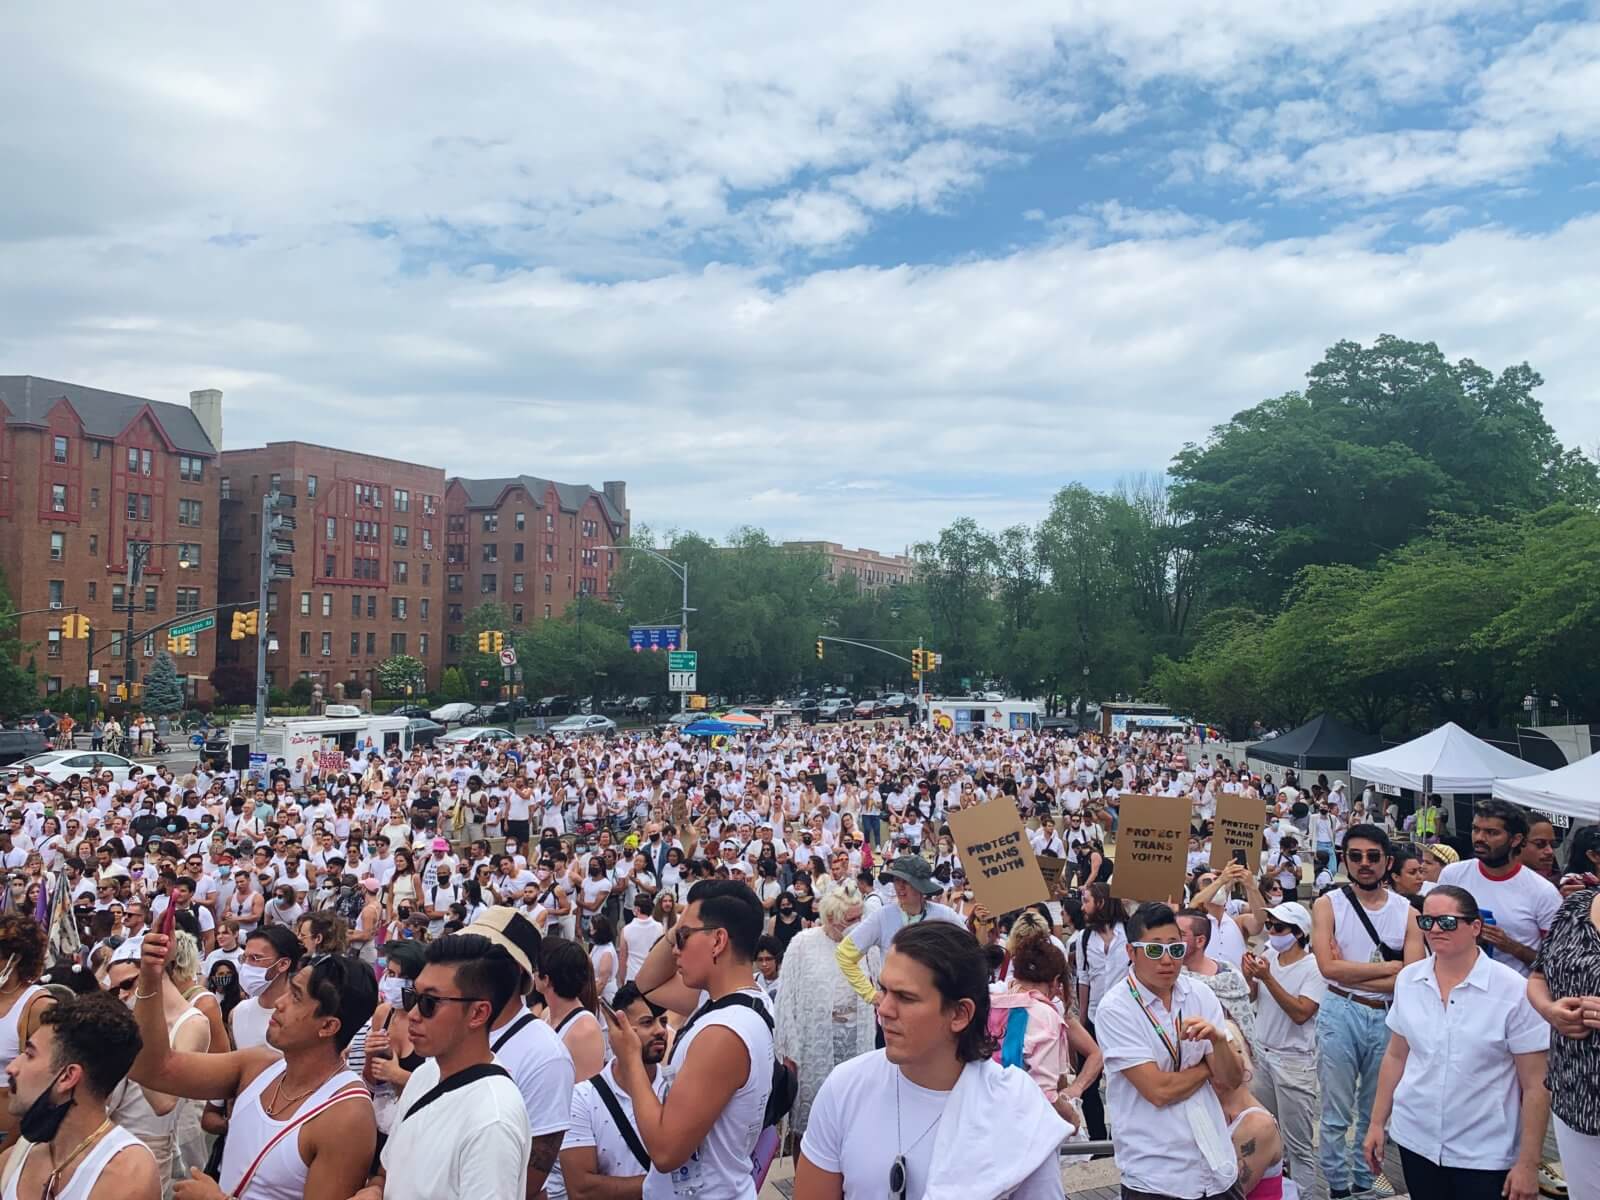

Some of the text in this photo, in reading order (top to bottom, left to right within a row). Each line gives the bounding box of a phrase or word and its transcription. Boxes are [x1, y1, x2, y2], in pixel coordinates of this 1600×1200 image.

[173, 623, 203, 635] Washington
[1221, 819, 1259, 830] PROTECT
[1126, 827, 1181, 839] PROTECT
[1226, 829, 1254, 839] TRANS
[967, 831, 1020, 856] PROTECT
[1133, 840, 1173, 851] TRANS
[1224, 837, 1253, 848] YOUTH
[978, 846, 1019, 866] TRANS
[1131, 852, 1172, 863] YOUTH
[982, 858, 1024, 878] YOUTH
